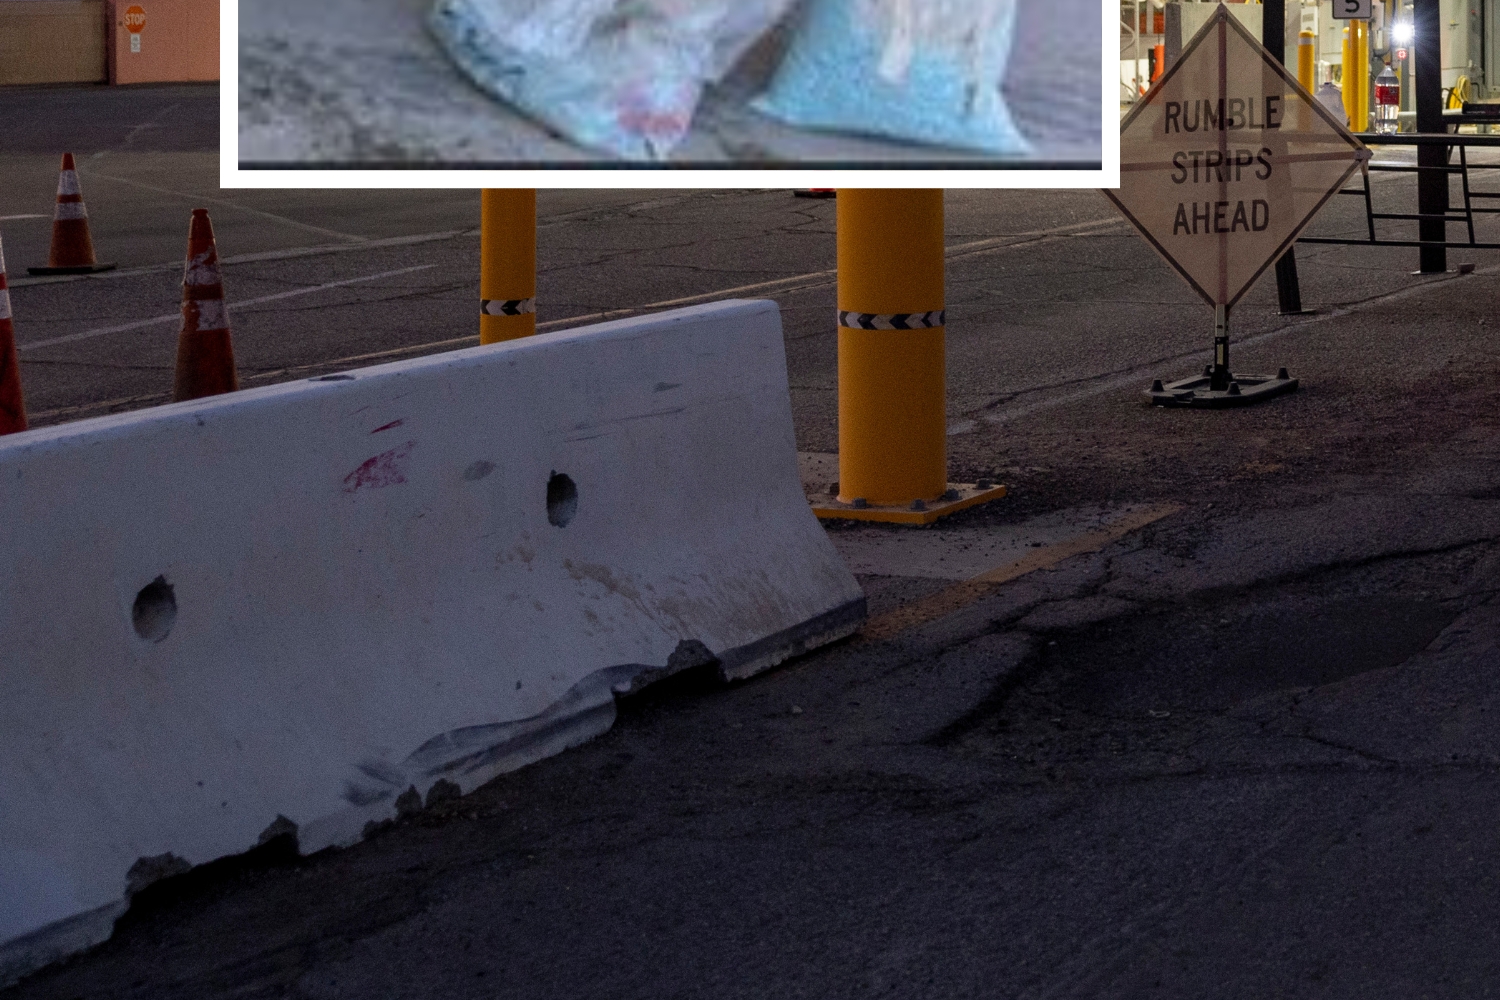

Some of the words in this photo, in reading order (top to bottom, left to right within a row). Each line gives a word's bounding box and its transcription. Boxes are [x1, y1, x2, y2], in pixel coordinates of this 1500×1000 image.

[125, 13, 146, 26] STOP
[1165, 95, 1282, 134] RUMBLE
[1171, 147, 1273, 184] STRIPS
[1173, 198, 1270, 235] AHEAD
